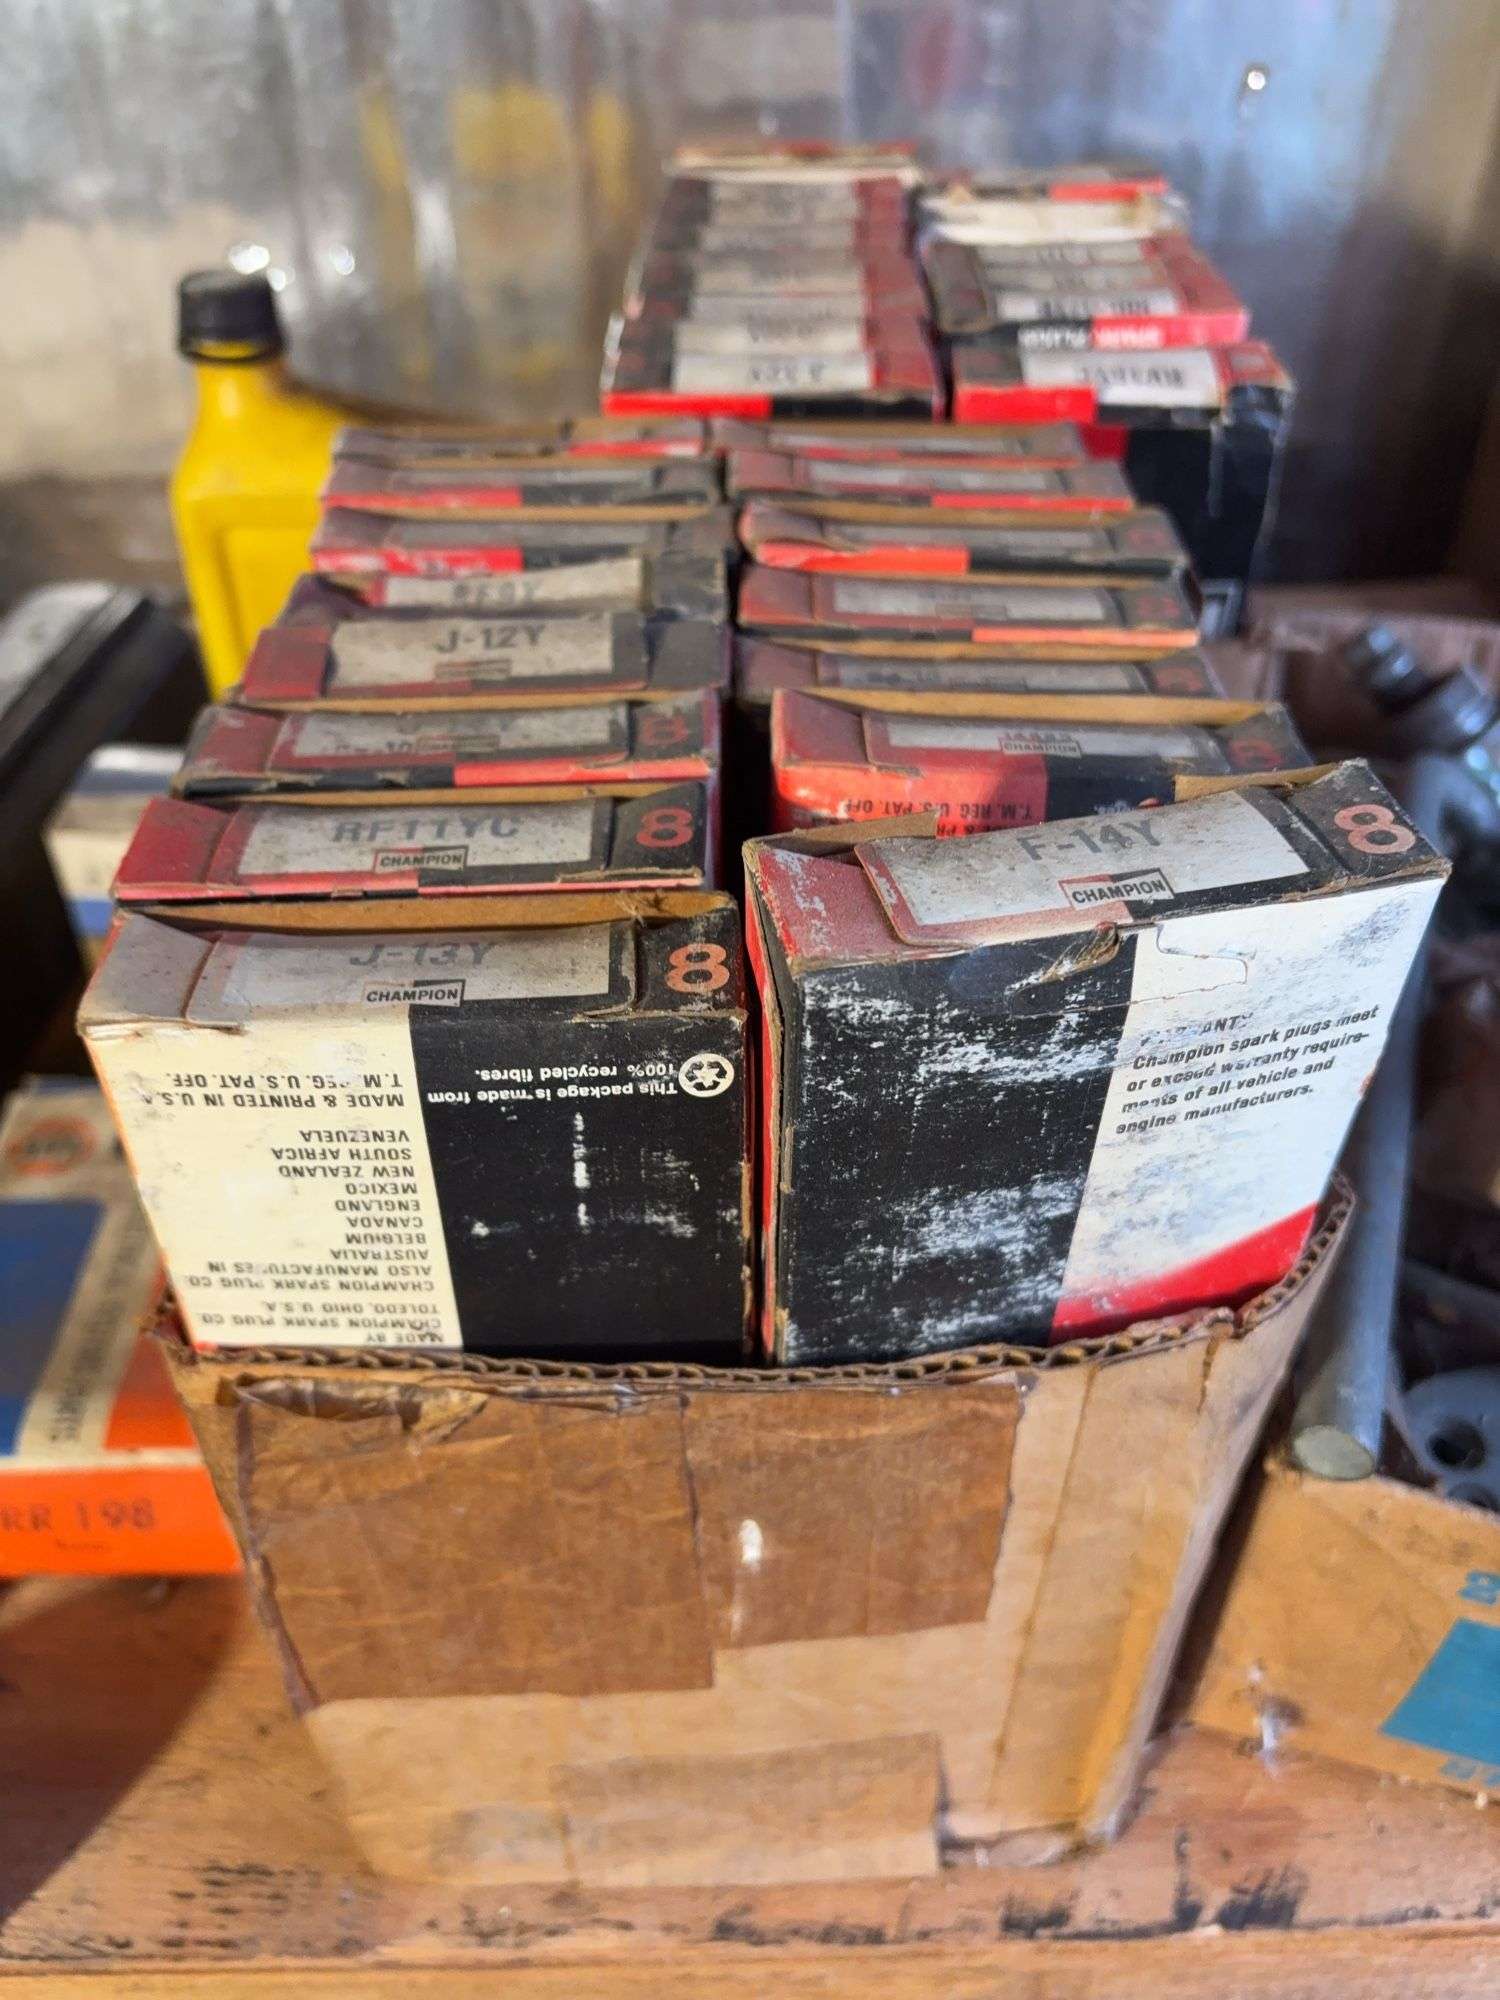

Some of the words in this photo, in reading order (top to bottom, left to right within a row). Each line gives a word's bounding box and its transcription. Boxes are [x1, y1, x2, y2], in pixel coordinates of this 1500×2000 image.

[435, 625, 544, 653] J-12Y
[332, 815, 520, 843] RF11YC
[635, 808, 693, 848] 8
[1333, 803, 1417, 855] 8
[1016, 819, 1164, 862] F-14Y
[380, 852, 463, 869] CHAMPION
[1071, 881, 1168, 905] CHAMPION
[349, 941, 497, 967] J-13Y
[664, 943, 731, 994] 8
[366, 986, 459, 1003] CHAMPION
[1132, 1042, 1226, 1071] Champion
[1229, 1028, 1280, 1052] spark
[1284, 1017, 1332, 1042] plugs
[1335, 1003, 1380, 1029] meet
[1126, 1078, 1147, 1093] or
[1151, 1062, 1217, 1088] exceed
[1220, 1045, 1300, 1075] warranty
[1301, 1032, 1371, 1058] require-
[475, 1066, 534, 1082] fibres.
[540, 1065, 617, 1082] recycled
[627, 1063, 675, 1078] 100%
[166, 1073, 207, 1088] OFF.
[212, 1073, 255, 1088] PAT.
[260, 1074, 300, 1088] U.S.
[1183, 1085, 1204, 1102] of
[1207, 1079, 1232, 1098] all
[1236, 1067, 1298, 1090] vehicle
[1302, 1056, 1336, 1076] and
[535, 1088, 552, 1100] is
[557, 1082, 634, 1100] package
[639, 1081, 678, 1095] This
[204, 1093, 225, 1107] IN
[233, 1093, 315, 1107] PRINTED
[323, 1094, 337, 1107] &
[347, 1093, 405, 1107] MADE
[427, 1090, 471, 1104] from
[477, 1088, 529, 1103] made
[1115, 1113, 1177, 1135] engine
[1183, 1084, 1314, 1122] manufacturers.
[299, 1130, 410, 1142] VENEZUELA
[271, 1148, 340, 1160] AFRICA
[349, 1148, 412, 1160] SOUTH
[279, 1165, 362, 1177] ZEALAND
[373, 1165, 415, 1177] NEW
[345, 1183, 418, 1194] MEXICO
[335, 1199, 421, 1212] ENGLAND
[347, 1216, 424, 1228] CANADA
[345, 1233, 427, 1245] BELGIUM
[329, 1249, 429, 1260] AUSTRALIA
[208, 1261, 226, 1273] IN
[389, 1265, 432, 1276] ALSO
[274, 1279, 330, 1290] SPARK
[339, 1280, 435, 1291] CHAMPION
[322, 1302, 364, 1313] OHIO
[285, 1316, 339, 1328] SPARK
[349, 1316, 442, 1329] CHAMPION
[366, 1332, 387, 1343] BY
